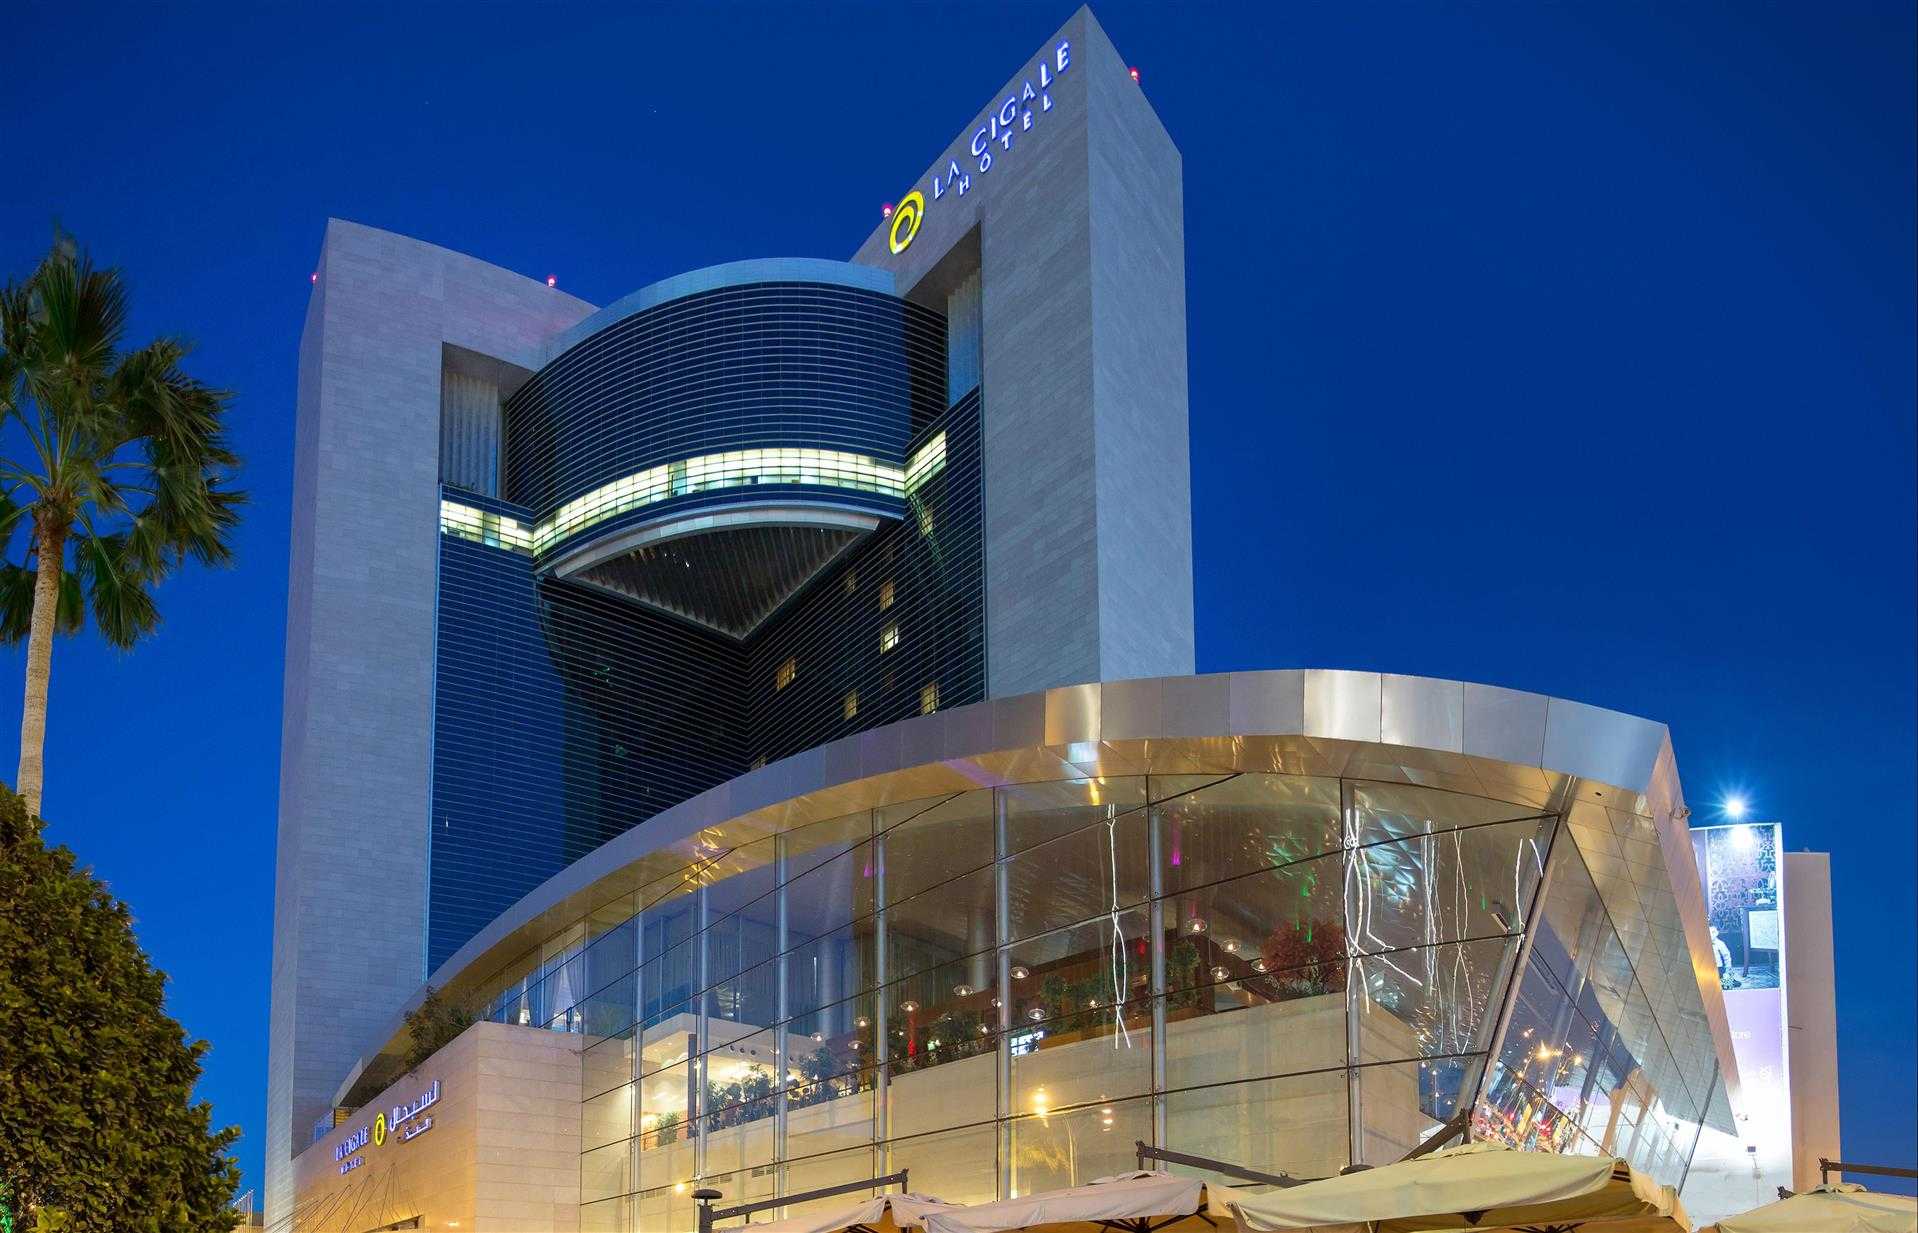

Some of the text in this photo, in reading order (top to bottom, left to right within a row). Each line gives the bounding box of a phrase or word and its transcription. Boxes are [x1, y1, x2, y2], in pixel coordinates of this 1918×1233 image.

[932, 42, 1070, 200] LA CIGALE
[958, 93, 1052, 197] HOTEL
